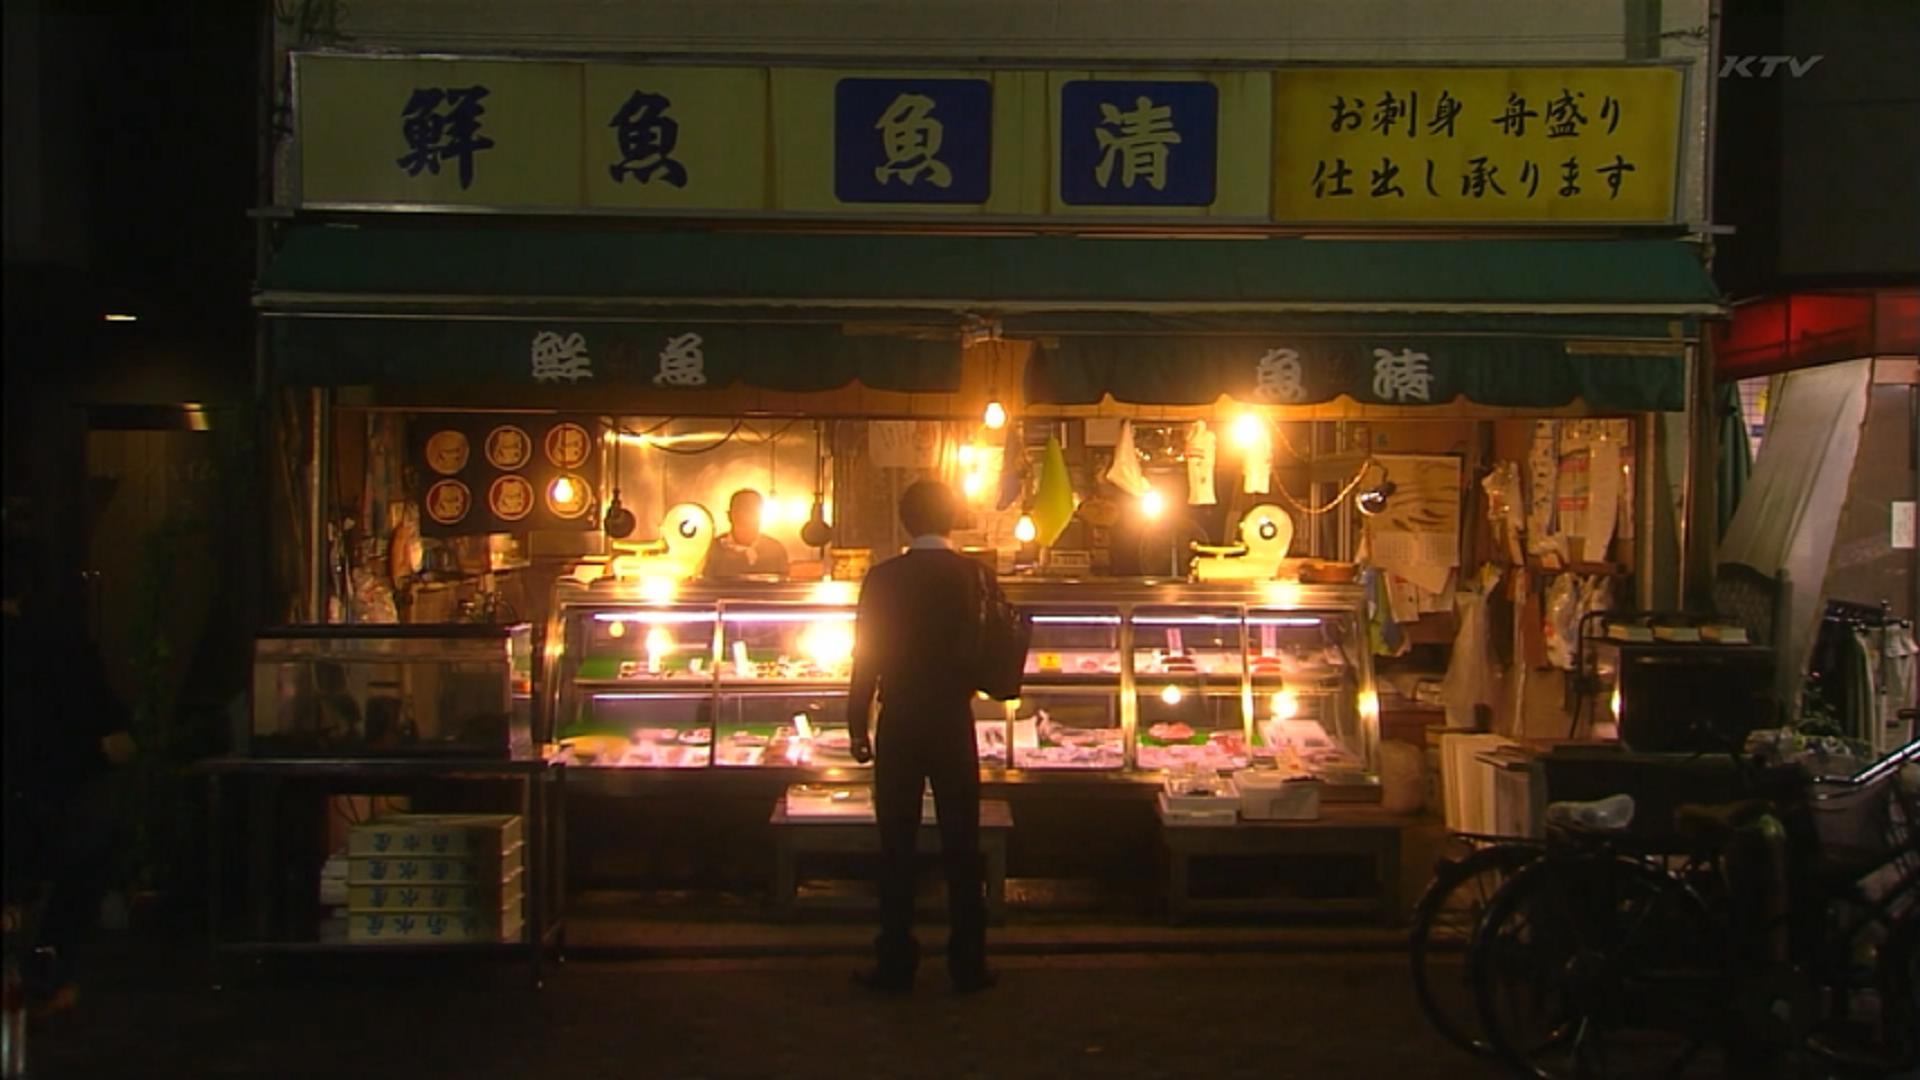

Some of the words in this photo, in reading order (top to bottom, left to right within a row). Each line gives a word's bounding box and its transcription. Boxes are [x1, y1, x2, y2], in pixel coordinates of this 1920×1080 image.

[396, 85, 689, 190] 鮮魚
[874, 91, 1182, 192] 魚清
[1329, 89, 1463, 138] お刺身
[1491, 88, 1620, 138] 舟盛り
[1311, 154, 1636, 200] 仕出し承ります
[530, 330, 708, 387] 鮮魚
